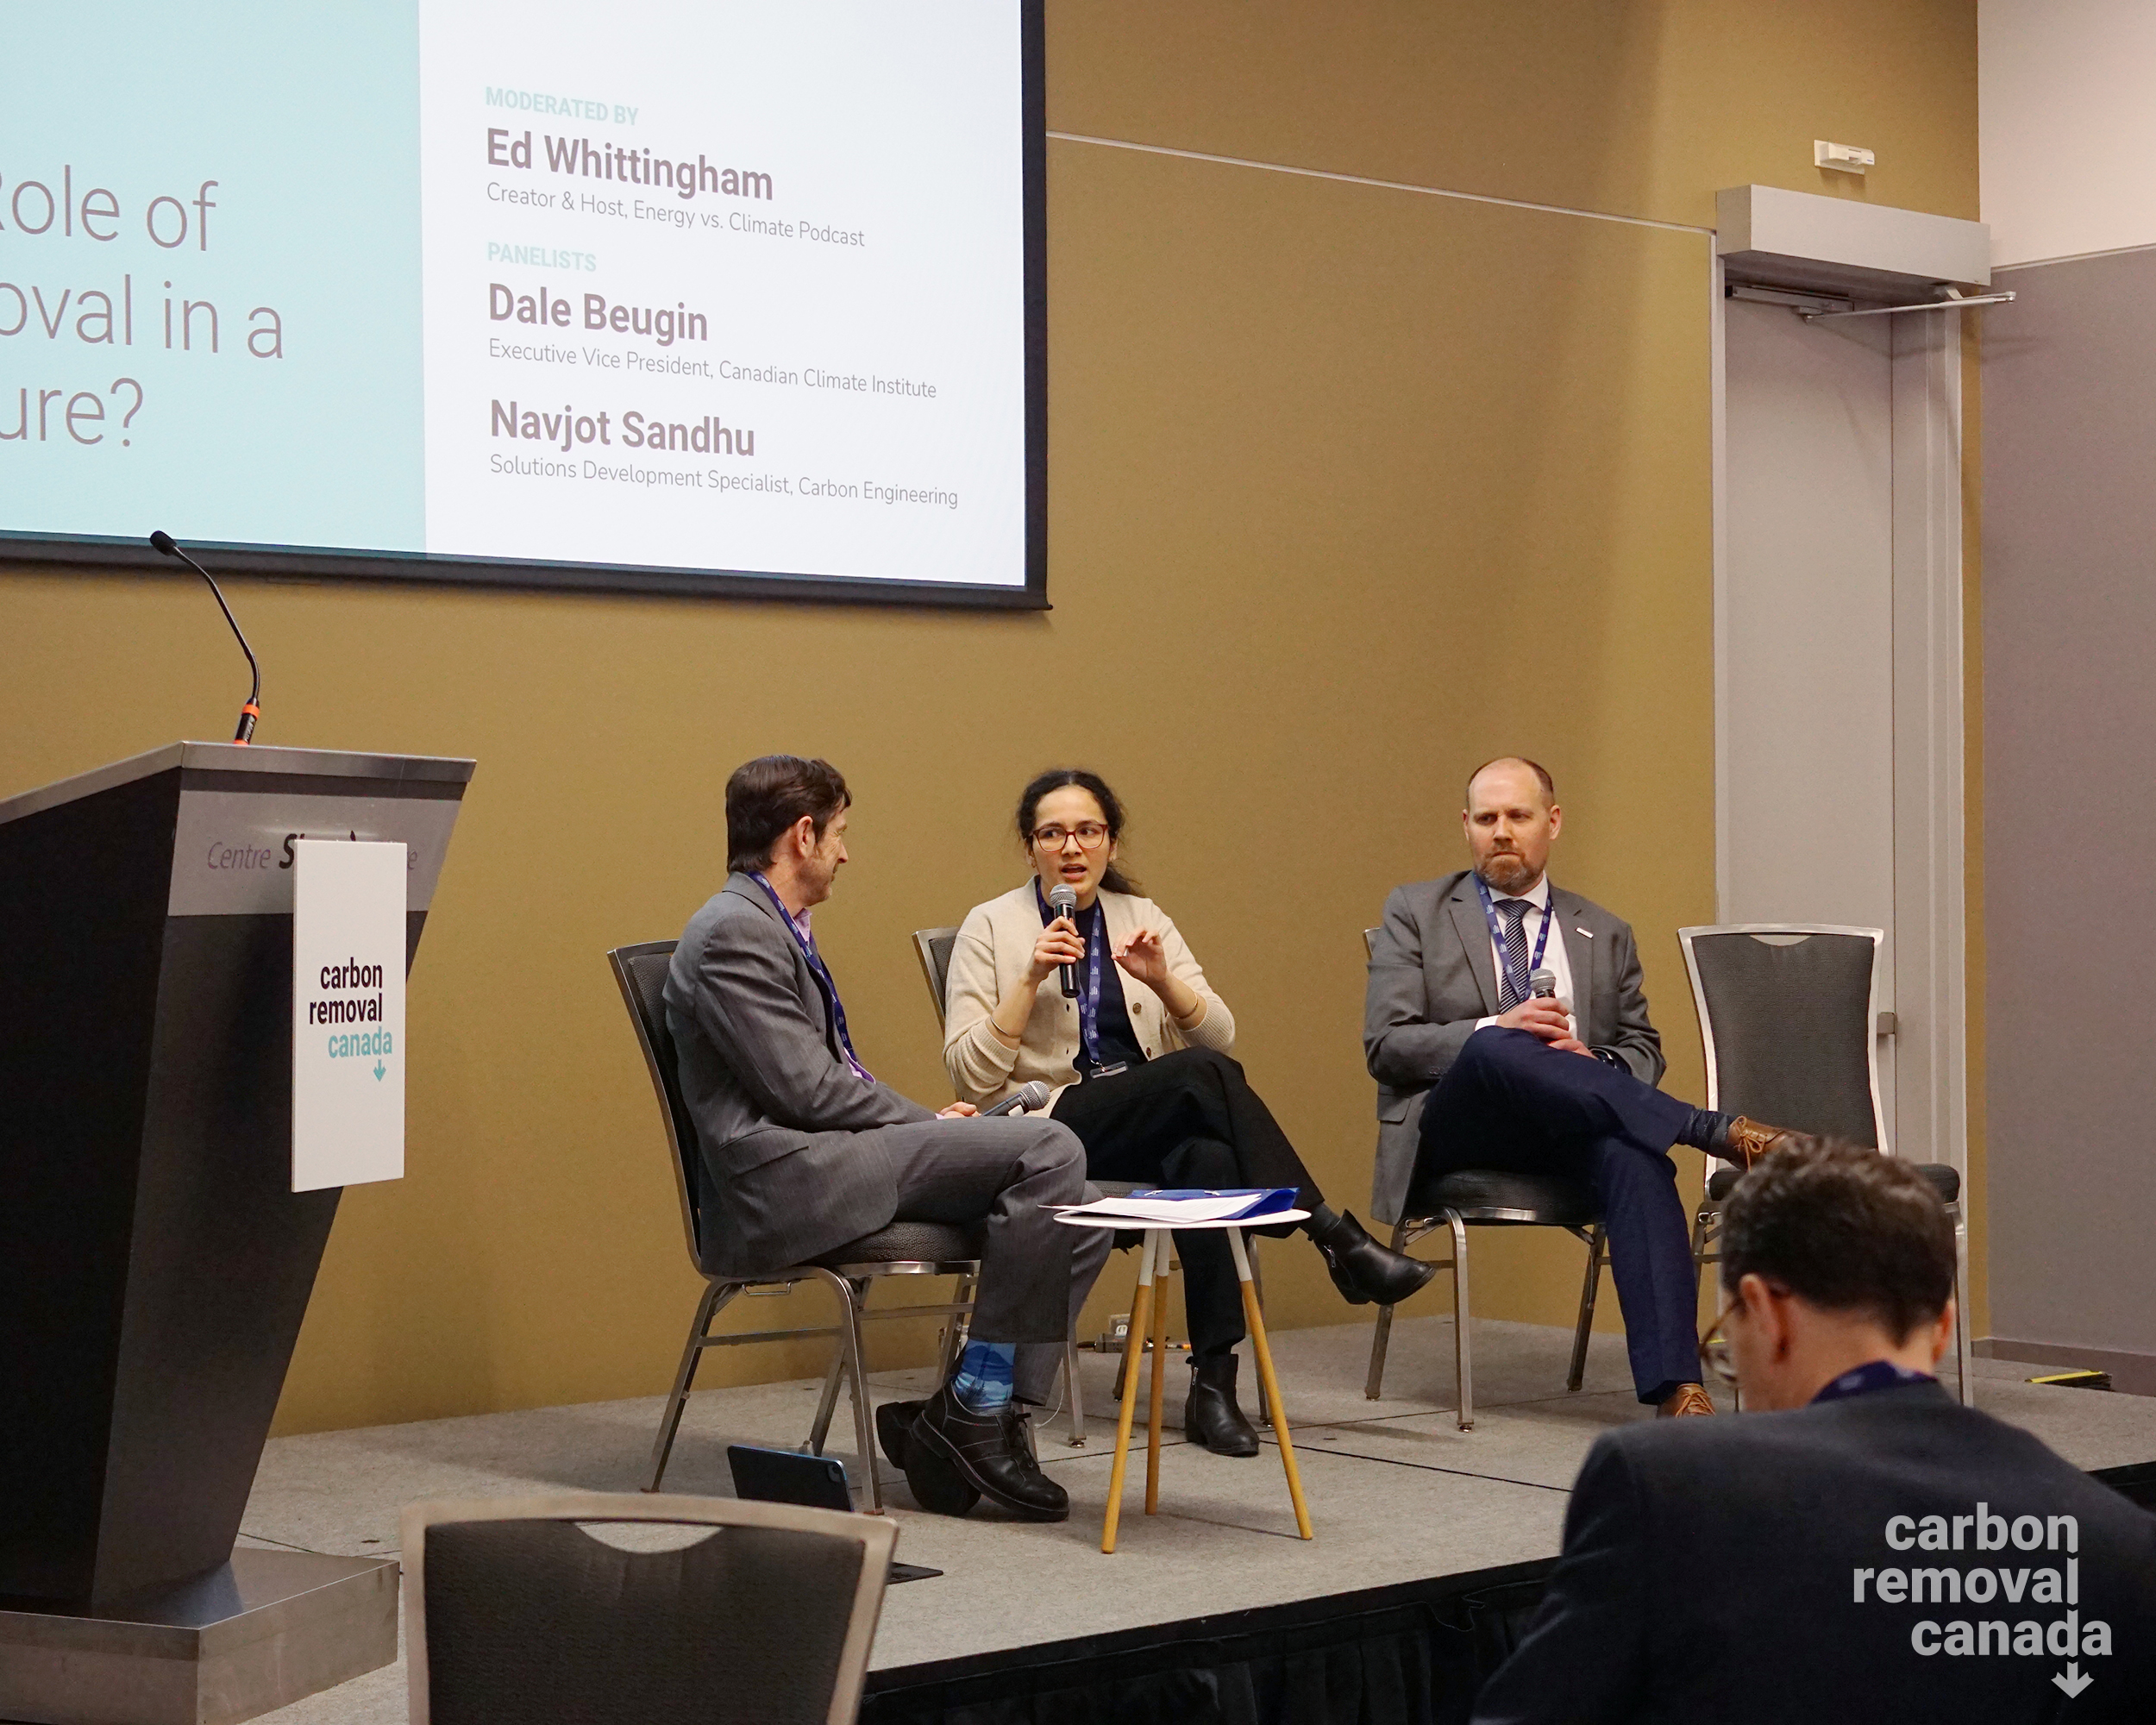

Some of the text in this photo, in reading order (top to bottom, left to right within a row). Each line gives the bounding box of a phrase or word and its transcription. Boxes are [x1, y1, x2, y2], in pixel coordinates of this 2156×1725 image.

[485, 85, 639, 126] MODERATED BY
[487, 127, 774, 201] Ed Whittingham
[0, 164, 219, 251] ole of
[486, 181, 865, 248] Creator & Host, Energy vs. Climate Podcast
[487, 241, 597, 273] PANELISTS
[164, 280, 218, 354] in
[248, 306, 283, 359] a
[489, 282, 708, 348] Dale Beugin
[489, 337, 937, 398] Executive Vice President, Canadian Climate Institute
[491, 398, 755, 457] Navjot Sandhu
[490, 450, 958, 511] Solutions Development Specialist, Carbon Engineering
[207, 841, 272, 869] Centre
[320, 957, 383, 989] carbon
[310, 992, 383, 1025] removal
[328, 1026, 392, 1058] canada
